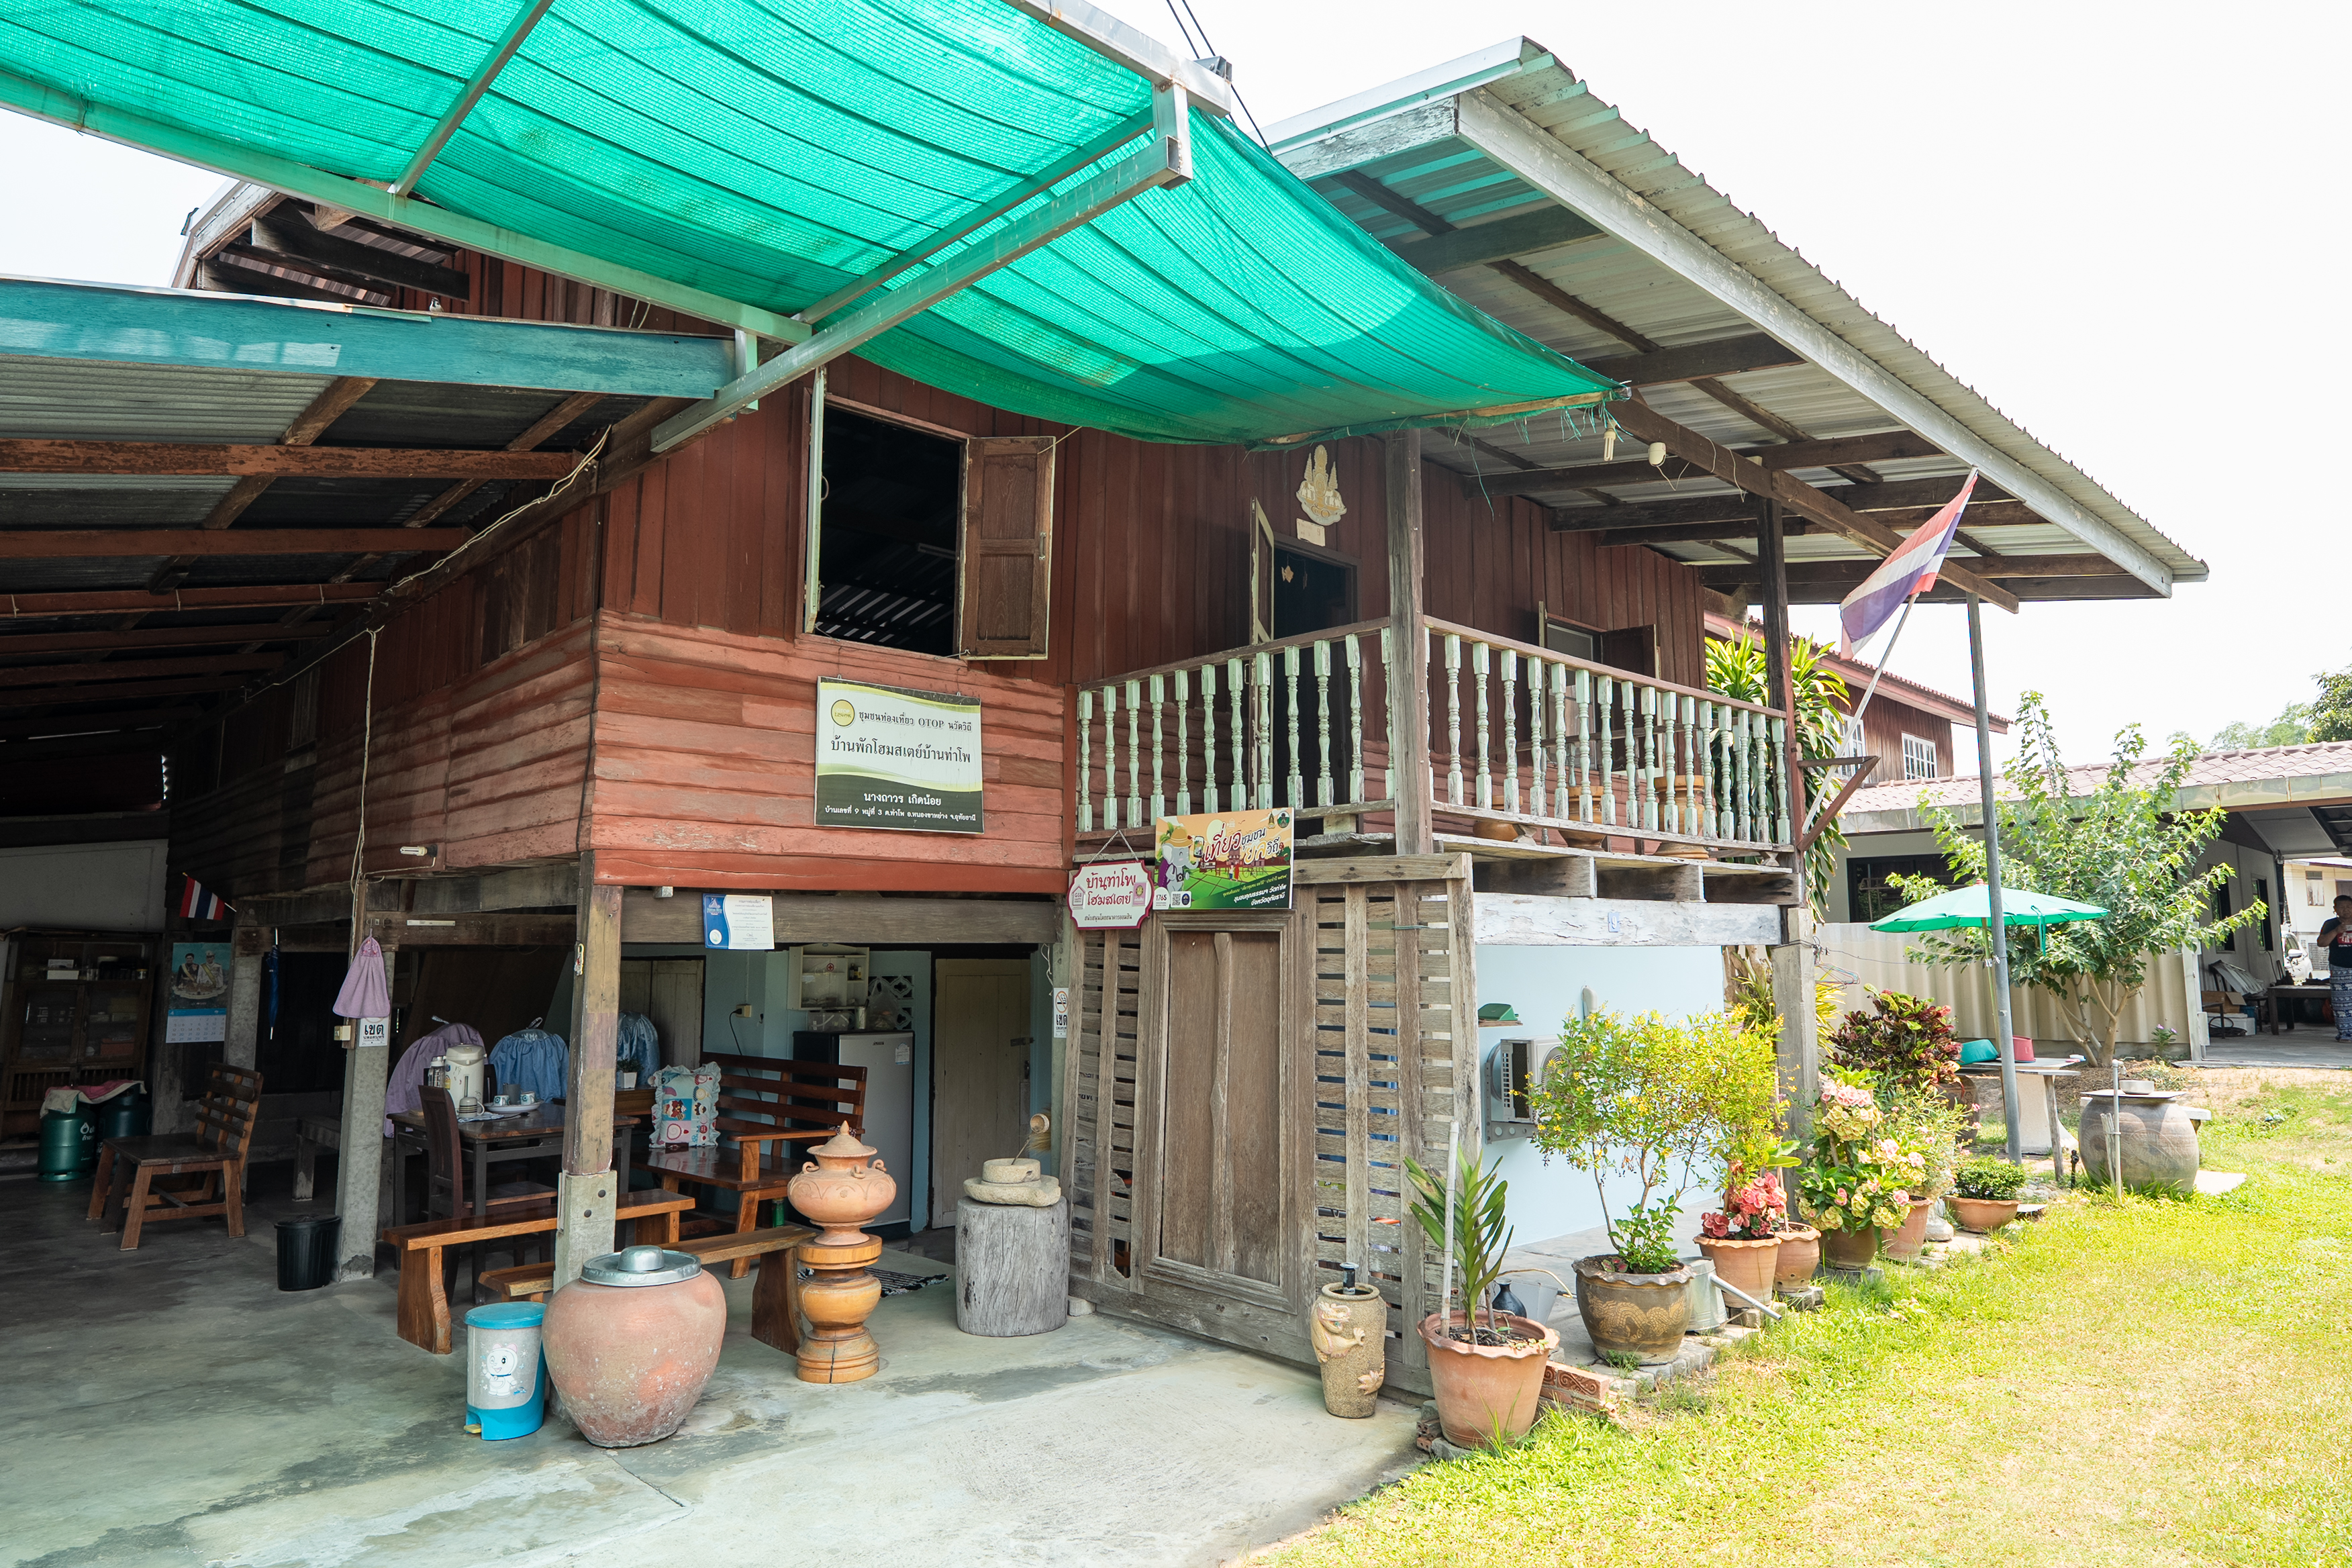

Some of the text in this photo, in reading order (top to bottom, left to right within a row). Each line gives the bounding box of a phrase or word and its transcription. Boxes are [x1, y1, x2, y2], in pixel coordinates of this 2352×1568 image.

[859, 711, 914, 725] ชุมชนท่องเที่ยว
[918, 718, 944, 728] OTOP
[948, 721, 972, 731] นวัตวิถี
[831, 735, 971, 763] บ้านพักโฮมสเตย์บ้านท่าโพ
[864, 793, 941, 806] นางถาวร เกิดน้อย
[825, 805, 852, 814] บ้านเลขที่
[862, 806, 875, 817] หมู่ที่
[1086, 867, 1136, 890] บ้านท่าโพ
[1087, 891, 1133, 905] โฮมสเตย์
[1056, 1014, 1067, 1026] เขต
[364, 1024, 384, 1035] เขต
